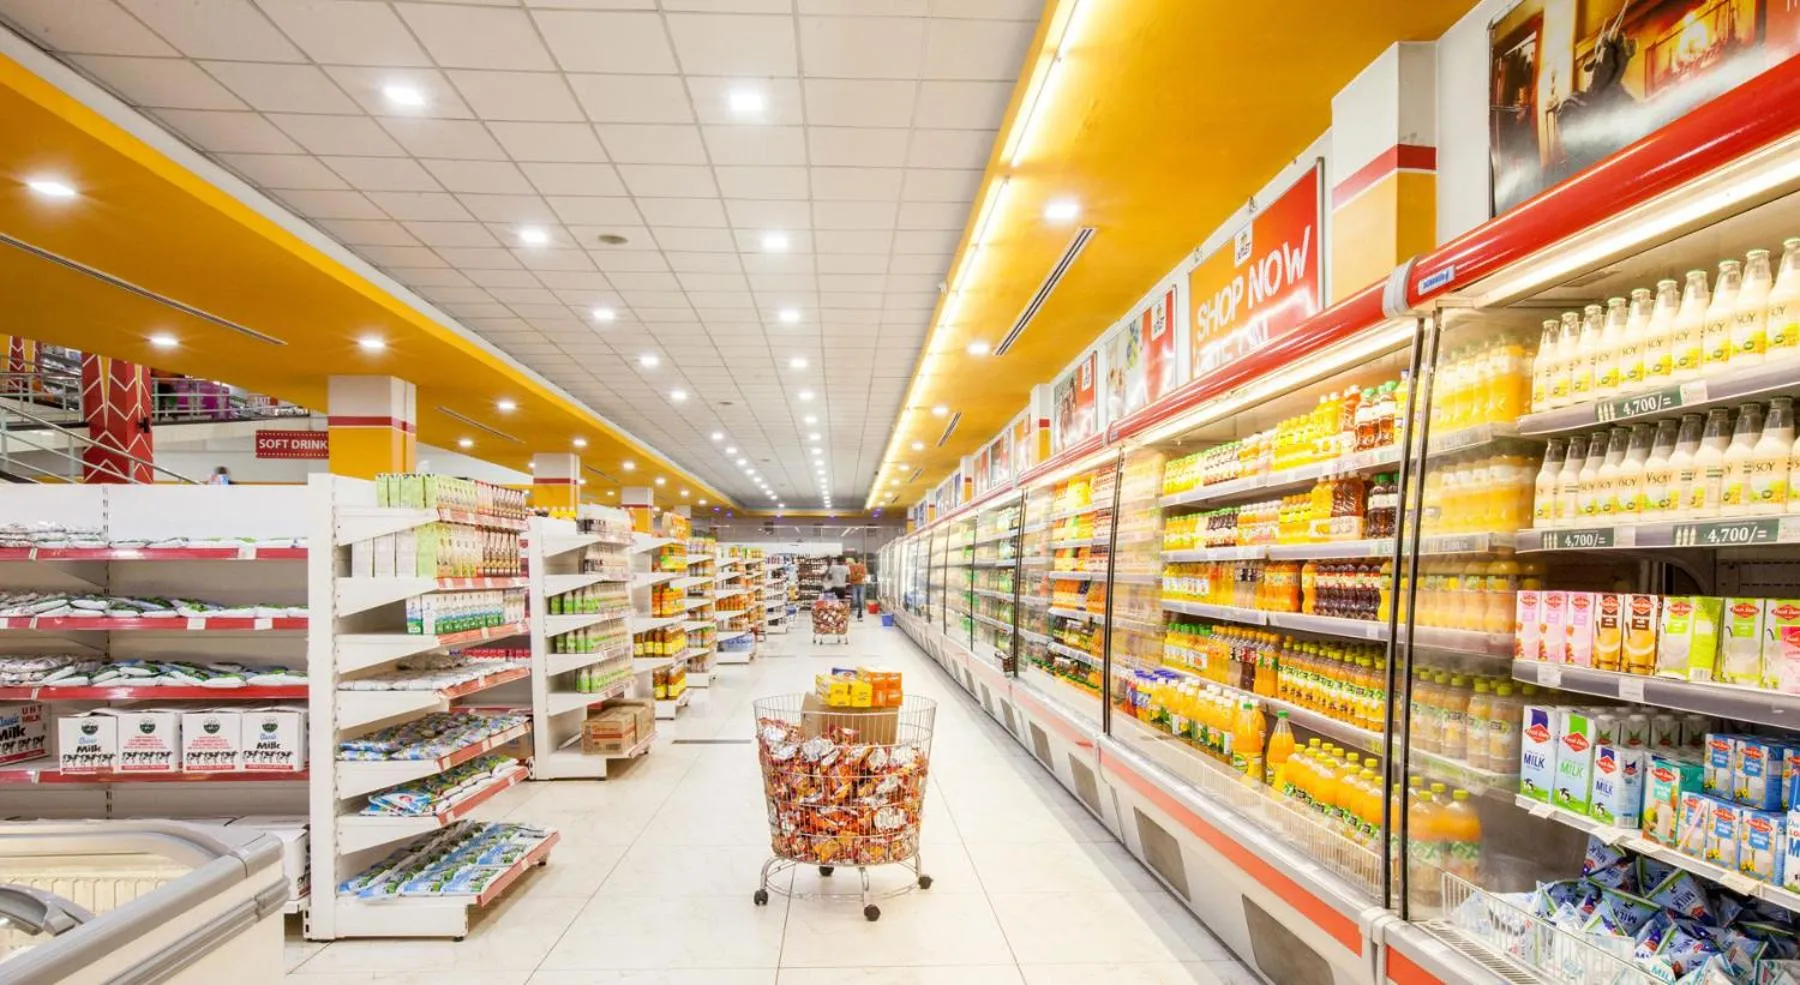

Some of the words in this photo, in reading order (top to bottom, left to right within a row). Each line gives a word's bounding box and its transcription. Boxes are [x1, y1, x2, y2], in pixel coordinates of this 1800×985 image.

[1197, 276, 1244, 342] SHOP
[1248, 225, 1311, 309] NOW
[1623, 394, 1672, 415] 4,700/=
[259, 439, 289, 449] SOFT
[291, 440, 328, 450] DRINK
[1564, 533, 1607, 548] 4,700/=
[1707, 526, 1768, 543] 4,700/=
[22, 705, 43, 715] UHT
[76, 745, 101, 753] Milk
[256, 741, 281, 749] Milk
[1524, 753, 1545, 769] MILK
[1560, 760, 1584, 777] MILK
[1595, 780, 1613, 795] MILK
[1673, 889, 1696, 909] MILK
